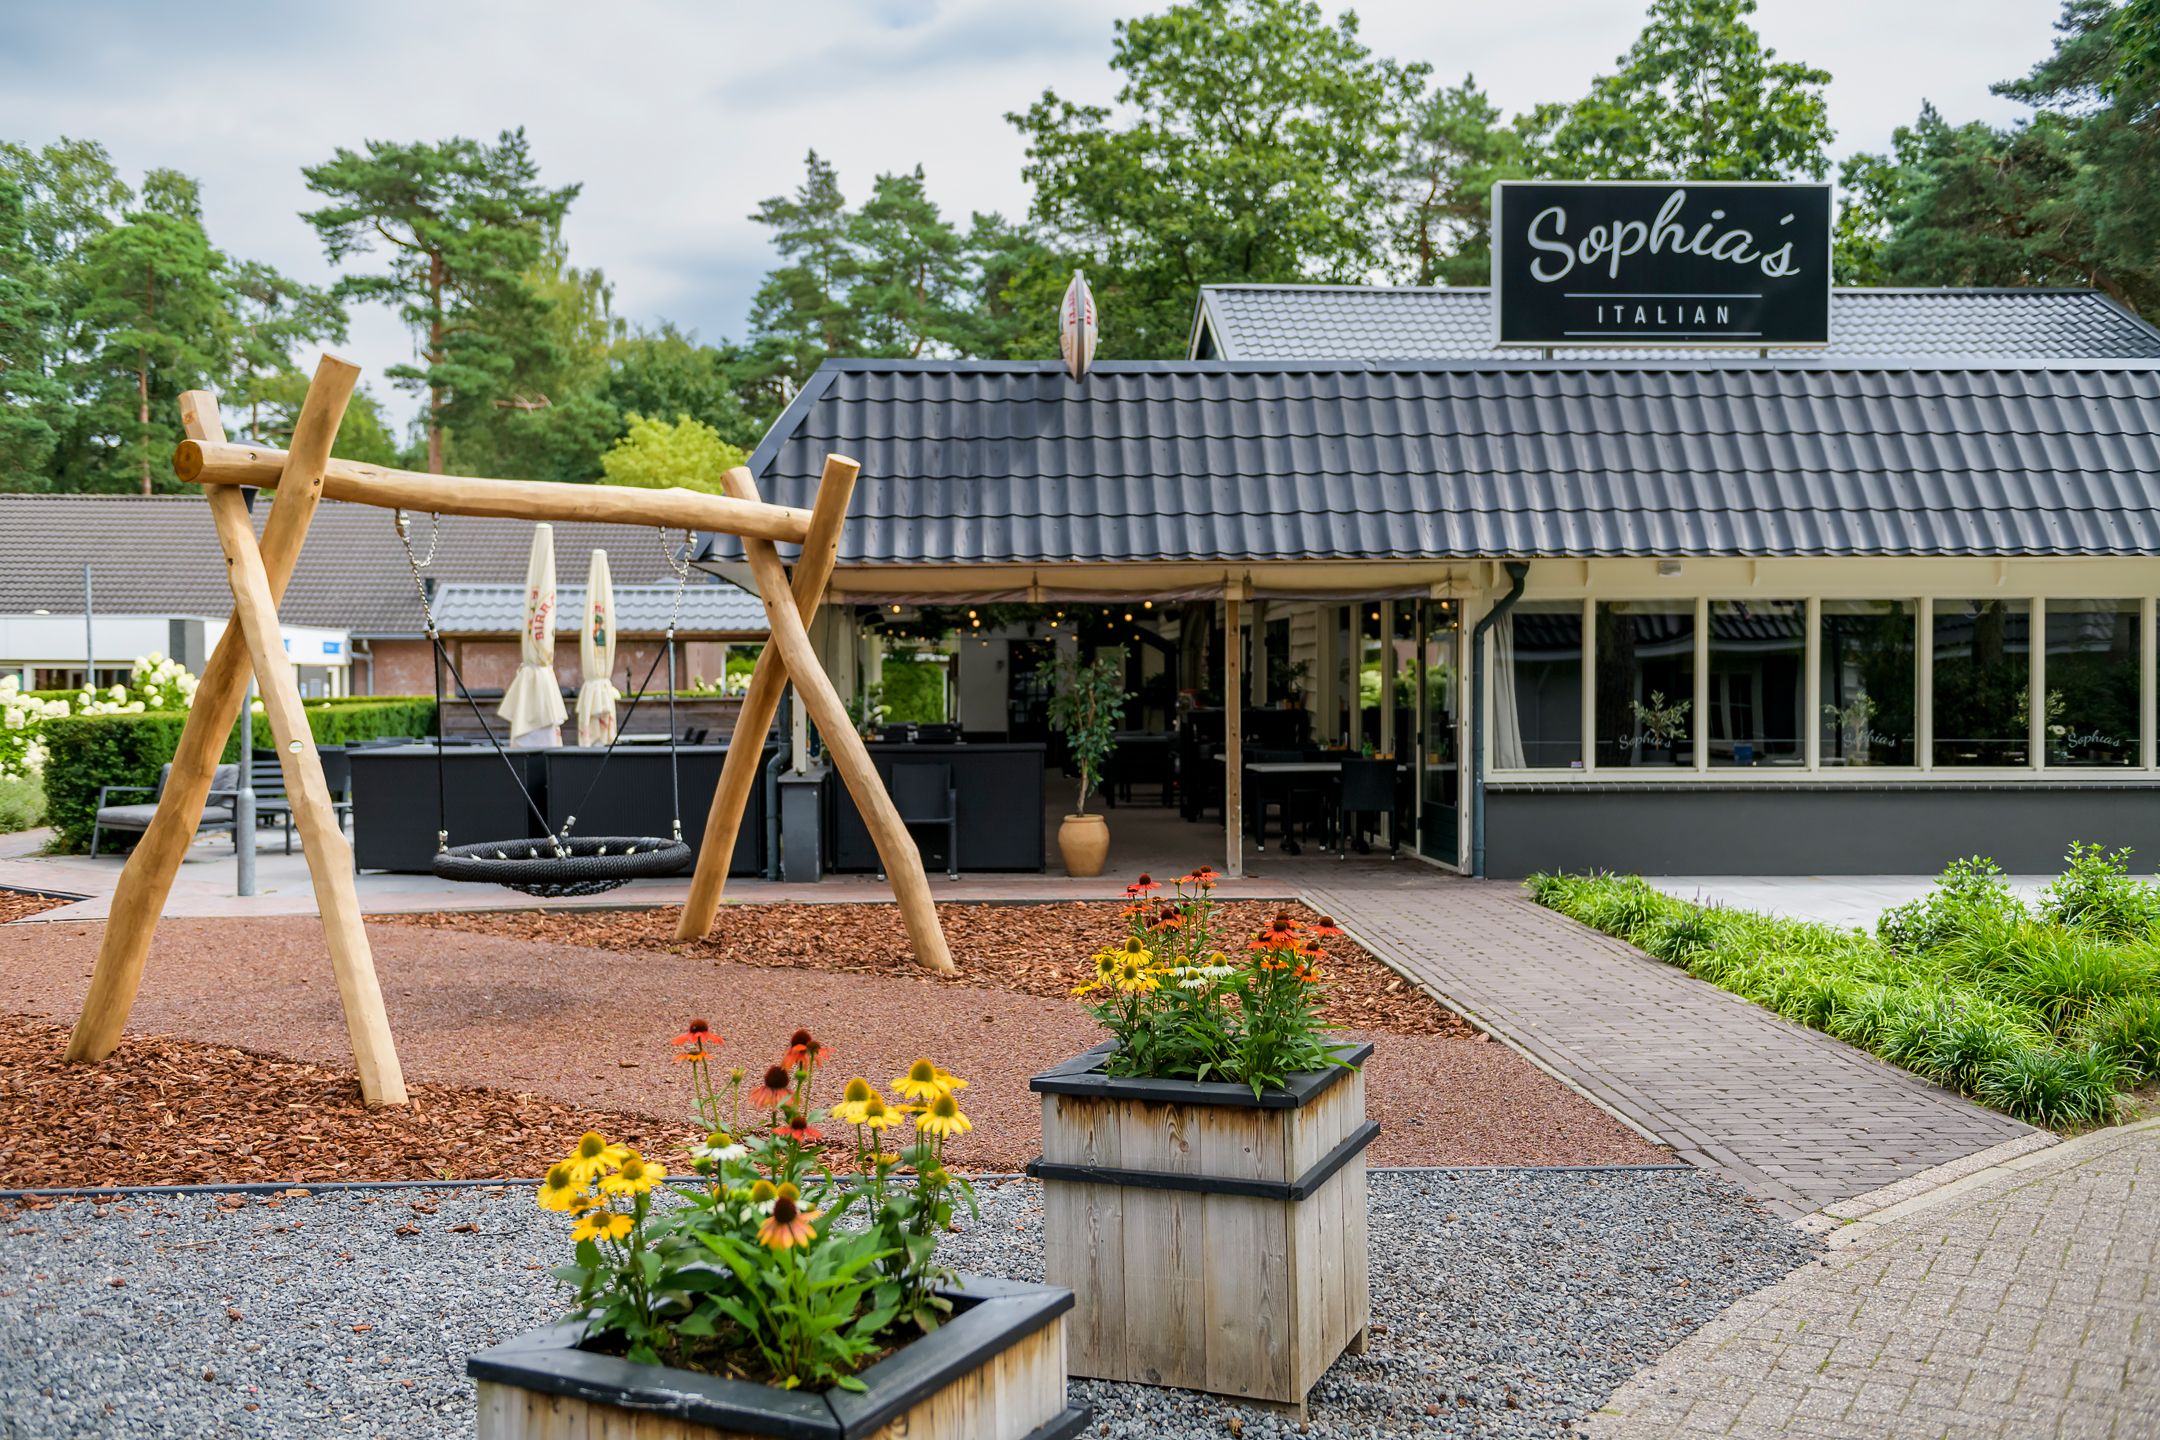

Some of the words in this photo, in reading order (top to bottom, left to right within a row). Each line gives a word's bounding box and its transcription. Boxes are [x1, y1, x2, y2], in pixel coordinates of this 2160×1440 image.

[1527, 188, 1801, 283] Sophia's
[1597, 304, 1730, 324] ITALIAN
[1619, 730, 1672, 750] Sophias
[2067, 729, 2120, 748] Sophias
